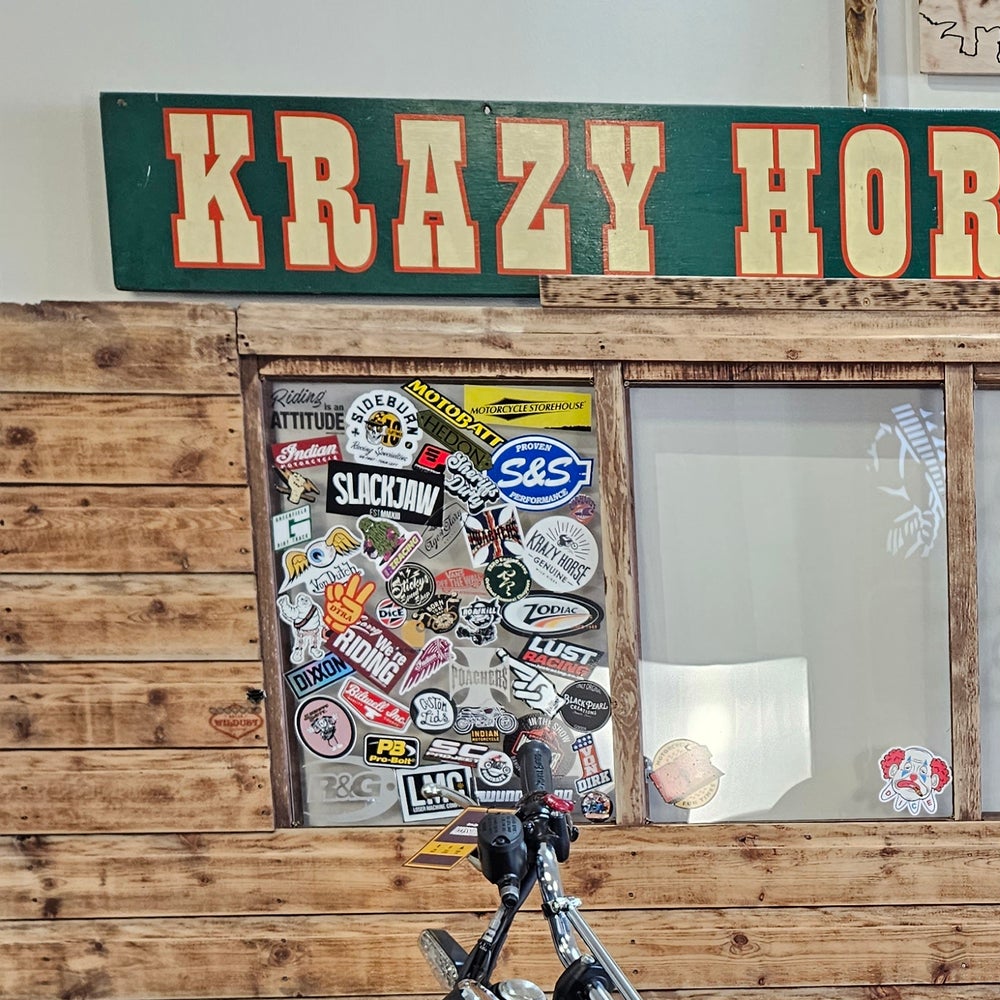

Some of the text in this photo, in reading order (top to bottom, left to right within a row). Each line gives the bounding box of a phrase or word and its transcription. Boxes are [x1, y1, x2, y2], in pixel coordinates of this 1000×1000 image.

[163, 108, 665, 275] KRAZY
[272, 388, 326, 408] Riding
[324, 403, 332, 411] is
[470, 401, 585, 415] MOTORCYCLE STOREHOUSE
[271, 411, 345, 430] ATTITUDE
[351, 394, 419, 436] SIDEBURN
[407, 379, 505, 447] MOTOBATT
[425, 414, 486, 467] HEDON
[516, 442, 552, 453] PROVEN
[275, 442, 338, 465] Indian
[497, 457, 573, 488] S&S
[332, 472, 440, 517] SLACKJAW
[509, 488, 569, 505] PERFORMANCE
[526, 530, 561, 561] KRAZY
[558, 553, 591, 586] HORSE
[329, 561, 358, 584] Dutch
[533, 557, 567, 584] GENUINE
[523, 604, 579, 625] ZODIAC
[333, 629, 400, 686] RIDING
[375, 634, 408, 666] We're
[528, 636, 598, 665] LUST
[293, 657, 347, 692] DIXXON
[522, 651, 590, 677] RACING
[451, 665, 508, 691] POACHERS
[345, 684, 390, 713] Biltwell
[564, 694, 609, 710] BLACK PEARL
[471, 730, 499, 738] INDIAN
[552, 723, 571, 743] SHOW
[377, 739, 407, 756] PB
[429, 739, 489, 759] SC
[369, 755, 412, 765] Pro-Bolt
[319, 772, 381, 798] R&G
[578, 770, 611, 792] DIRK
